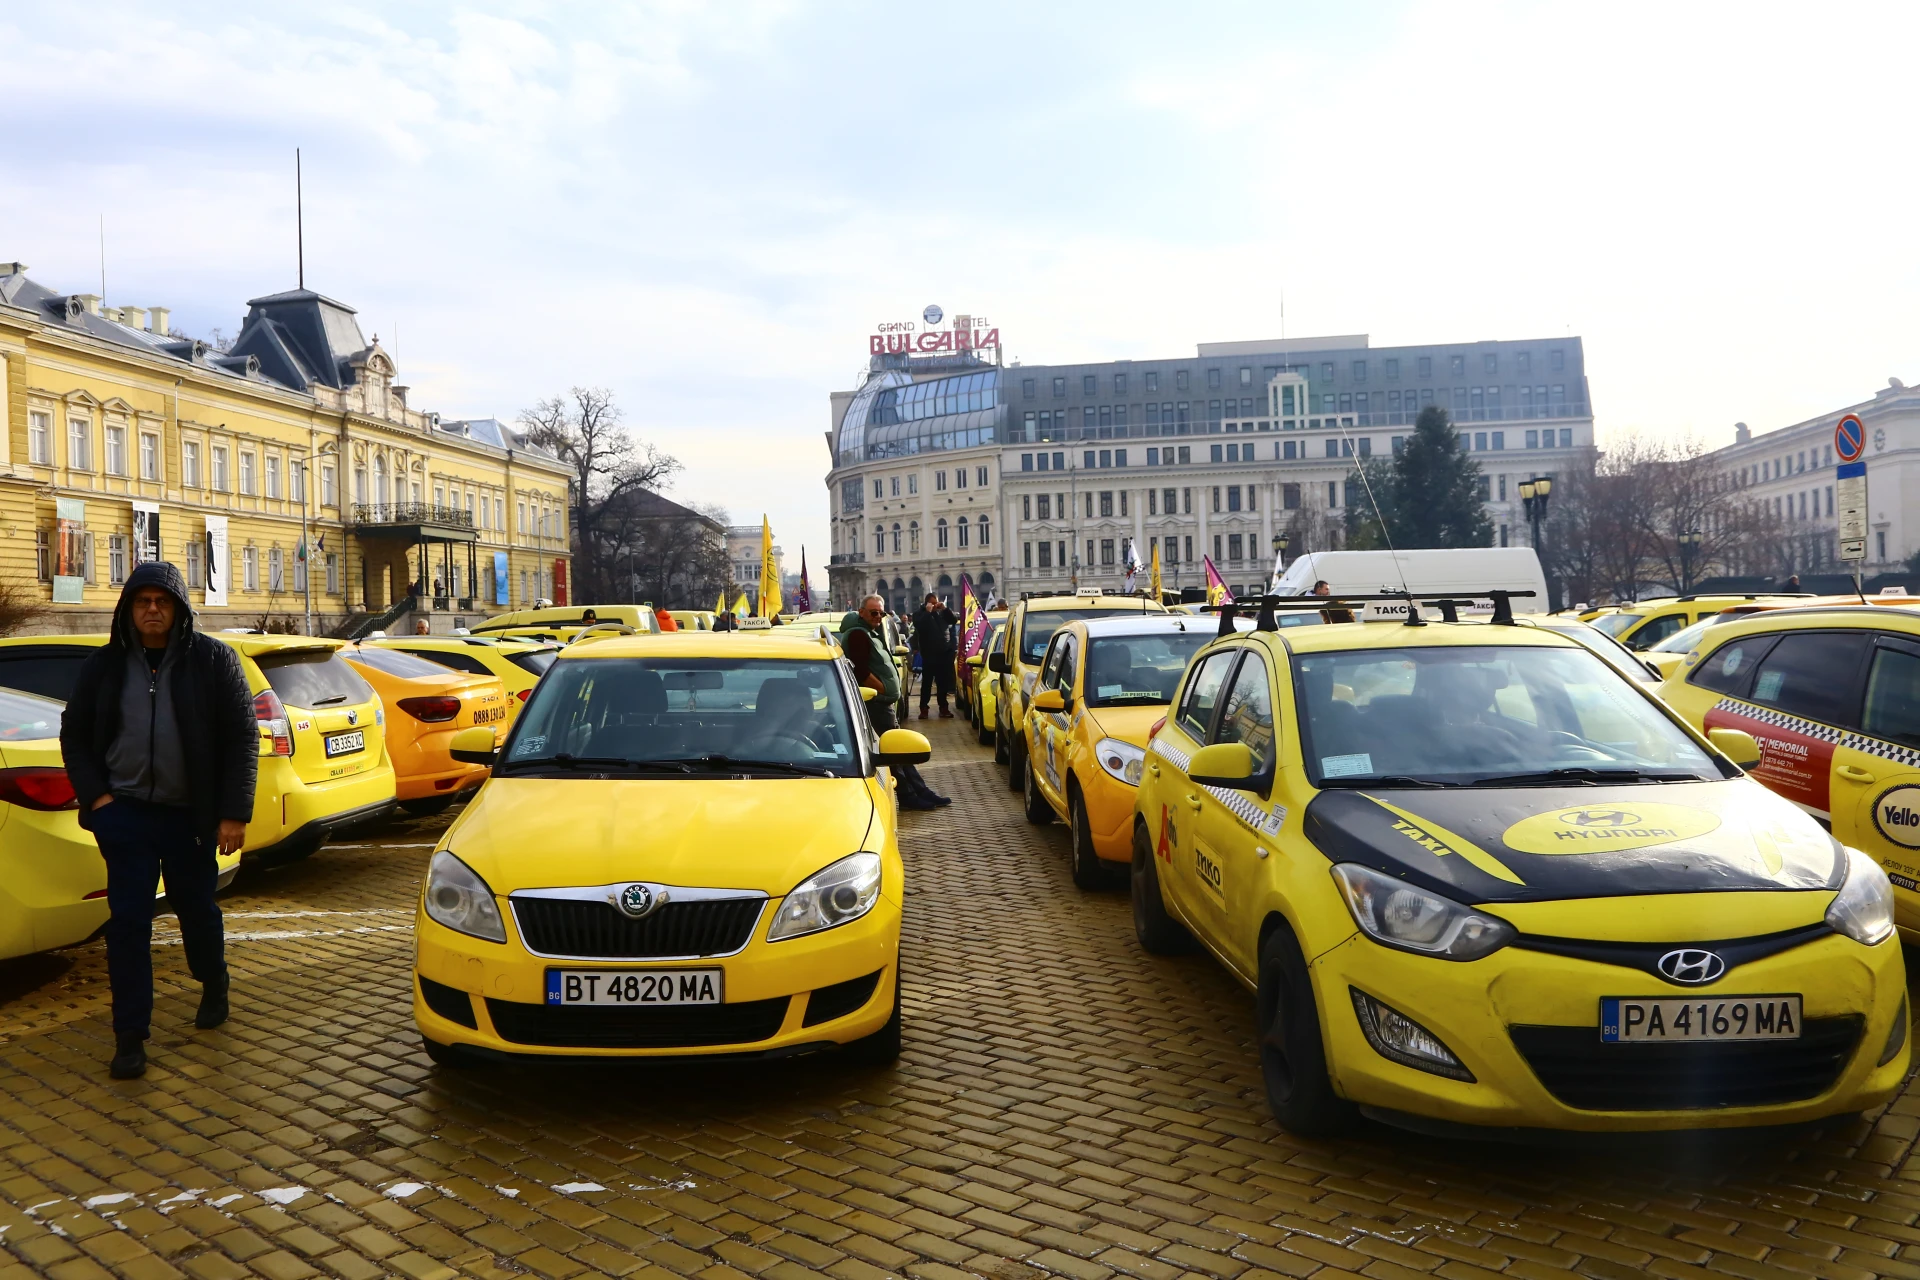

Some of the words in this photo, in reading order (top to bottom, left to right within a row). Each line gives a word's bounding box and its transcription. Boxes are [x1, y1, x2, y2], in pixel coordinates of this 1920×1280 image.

[878, 322, 914, 332] GRAND
[954, 318, 990, 328] HOTEL
[870, 329, 999, 355] BULGARIA
[297, 721, 309, 731] 345
[1768, 739, 1808, 756] MEMORIAL
[1884, 806, 1920, 827] Yello
[1391, 819, 1453, 857] TAXI
[1553, 828, 1678, 841] HYUNDAI
[1195, 848, 1221, 887] ТИКО
[549, 992, 560, 1000] BG
[566, 975, 601, 1002] BT
[607, 975, 674, 1002] 4820
[679, 974, 715, 1001] MA
[1604, 1025, 1618, 1035] BG
[1624, 1004, 1666, 1036] PA
[1673, 1003, 1749, 1036] 4169
[1755, 1001, 1795, 1034] MA
